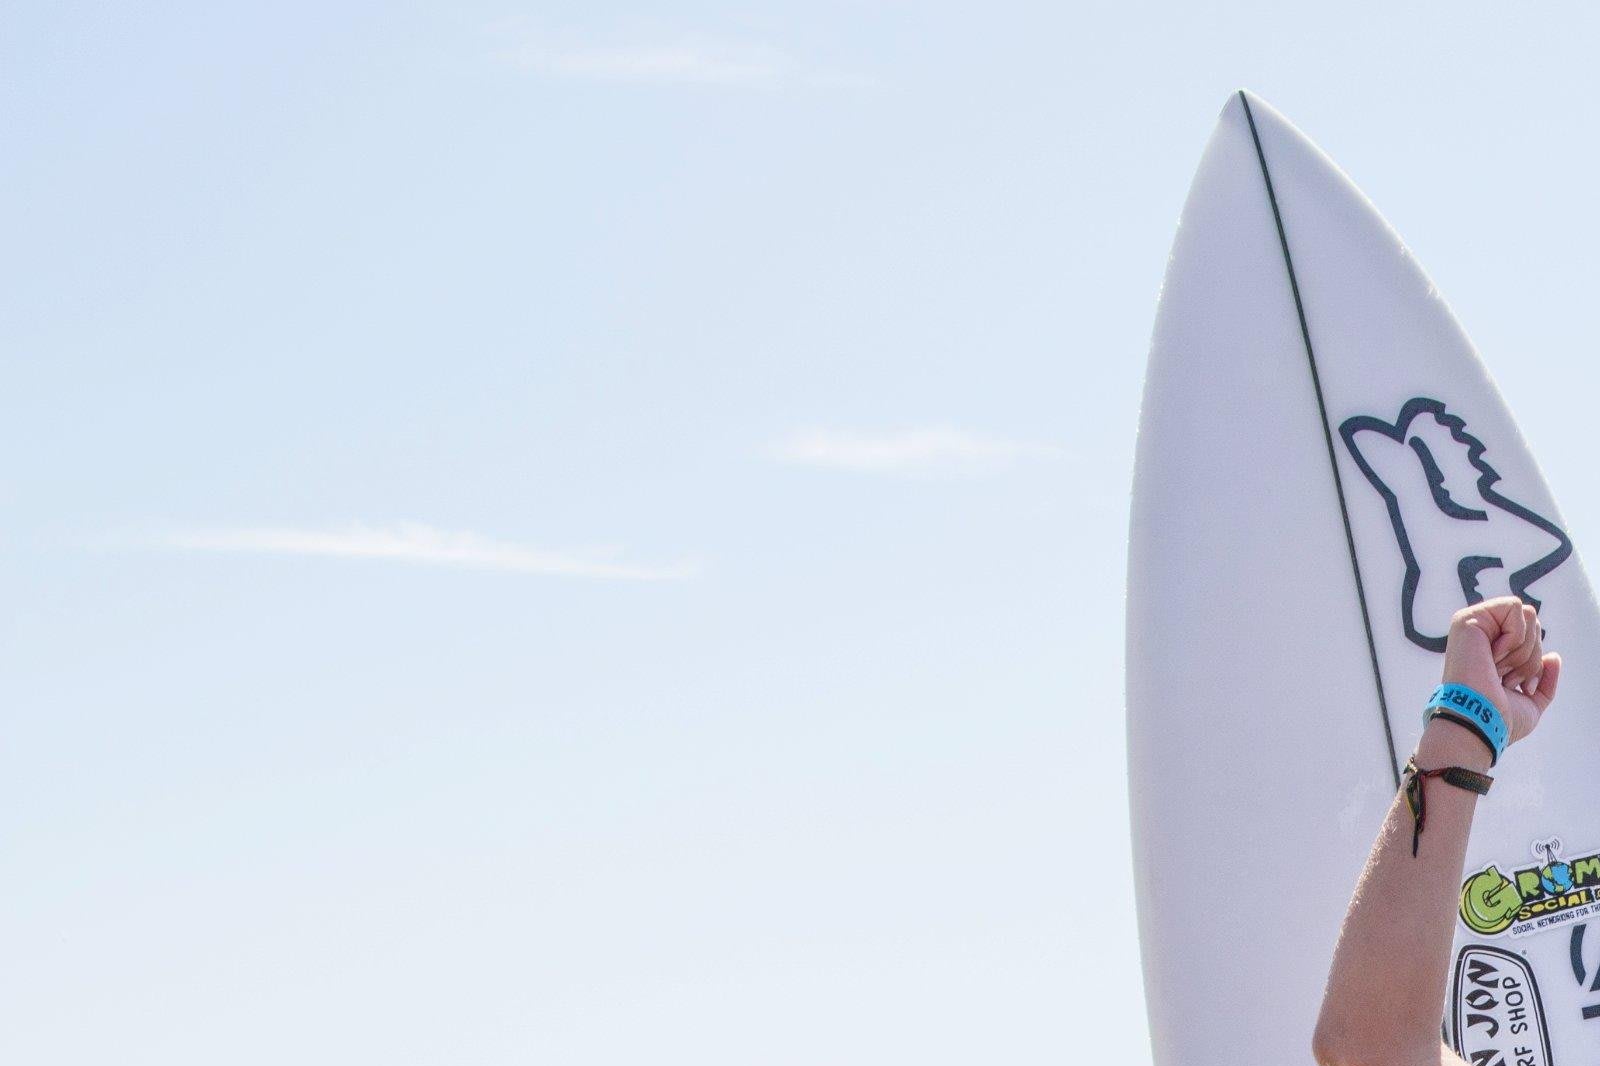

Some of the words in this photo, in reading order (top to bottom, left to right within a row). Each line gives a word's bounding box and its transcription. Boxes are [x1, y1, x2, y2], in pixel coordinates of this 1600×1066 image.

[1512, 923, 1535, 935] SOCIAL
[1537, 911, 1575, 928] NETWORKING
[1576, 907, 1588, 917] FOR
[1465, 959, 1499, 1038] JON
[1502, 976, 1528, 1035] SHOP
